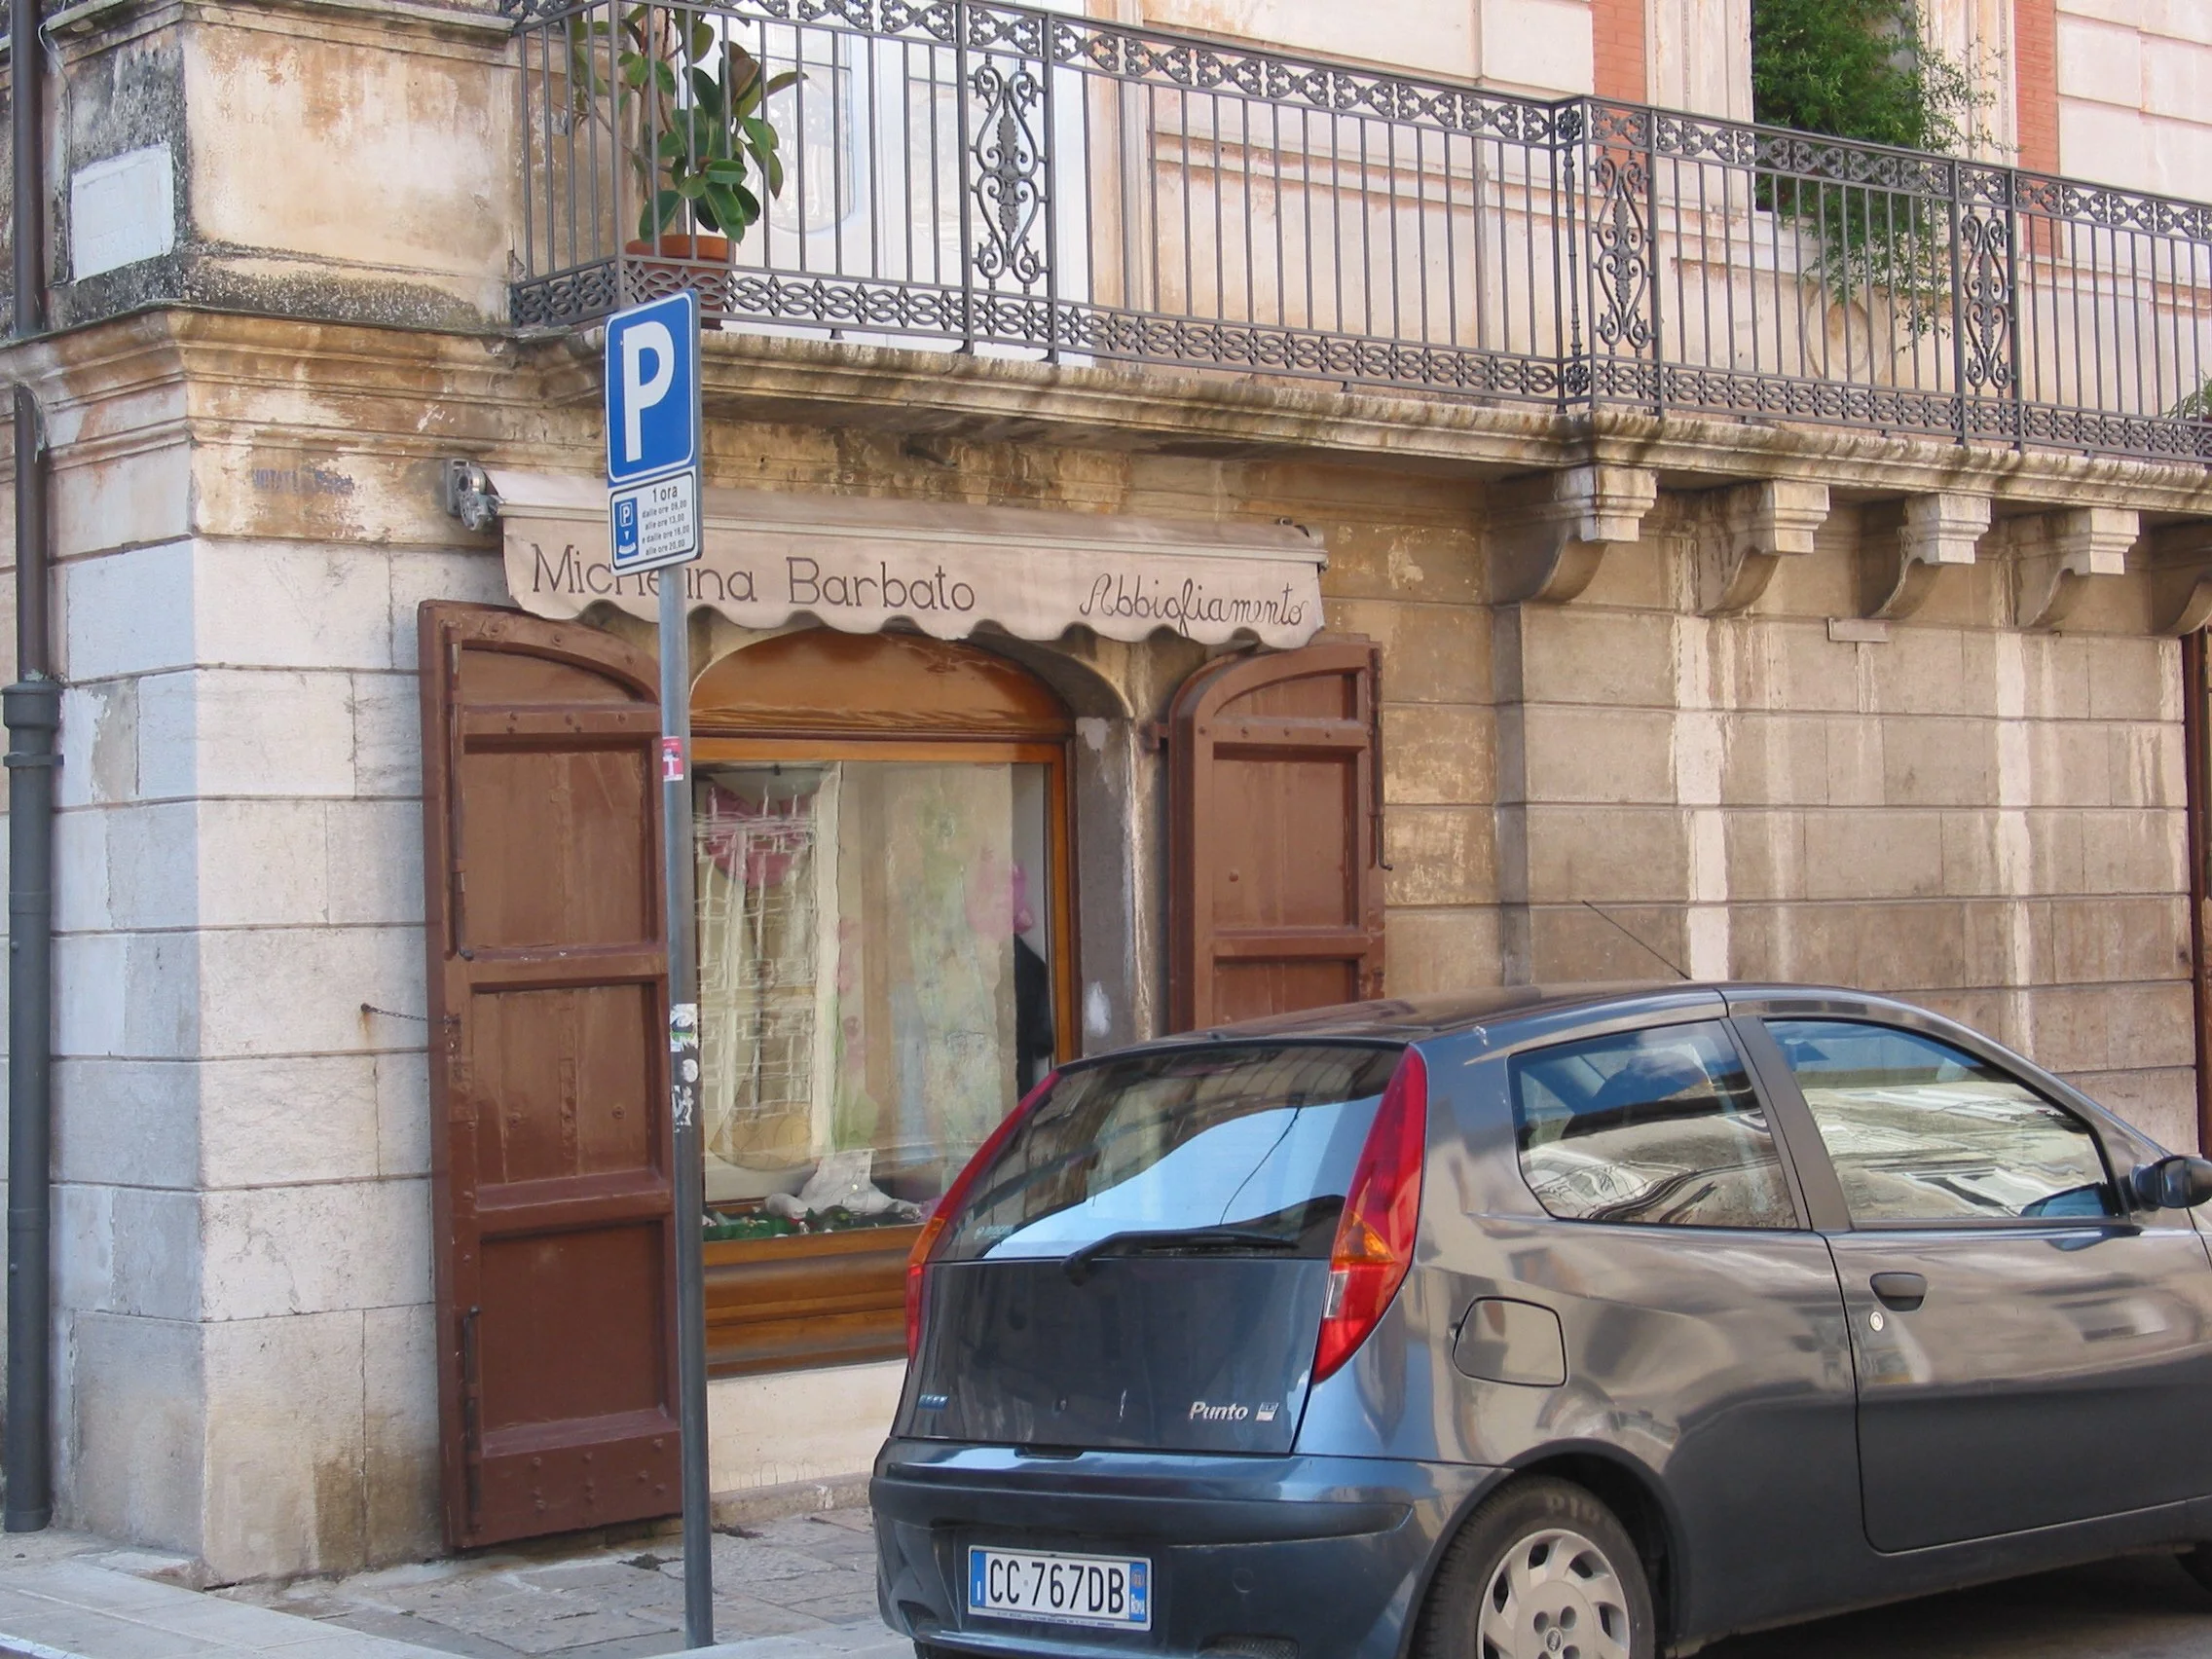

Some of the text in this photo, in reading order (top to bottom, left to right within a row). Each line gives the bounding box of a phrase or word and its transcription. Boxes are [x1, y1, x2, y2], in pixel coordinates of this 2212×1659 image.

[623, 321, 676, 462] P
[652, 486, 678, 503] 1 ora
[622, 505, 631, 524] P
[643, 507, 657, 518] dalle
[658, 505, 669, 514] ore
[645, 521, 656, 531] alle
[657, 519, 668, 528] ore
[646, 533, 662, 542] dalle
[663, 530, 674, 539] ore
[645, 546, 657, 556] alle
[658, 544, 668, 553] ore
[532, 543, 975, 611] Miceina Barbato
[1079, 572, 1309, 638] Abbigliamento
[1189, 1401, 1249, 1420] Punto
[989, 1559, 1020, 1604] CC
[1030, 1562, 1124, 1614] 767DB
